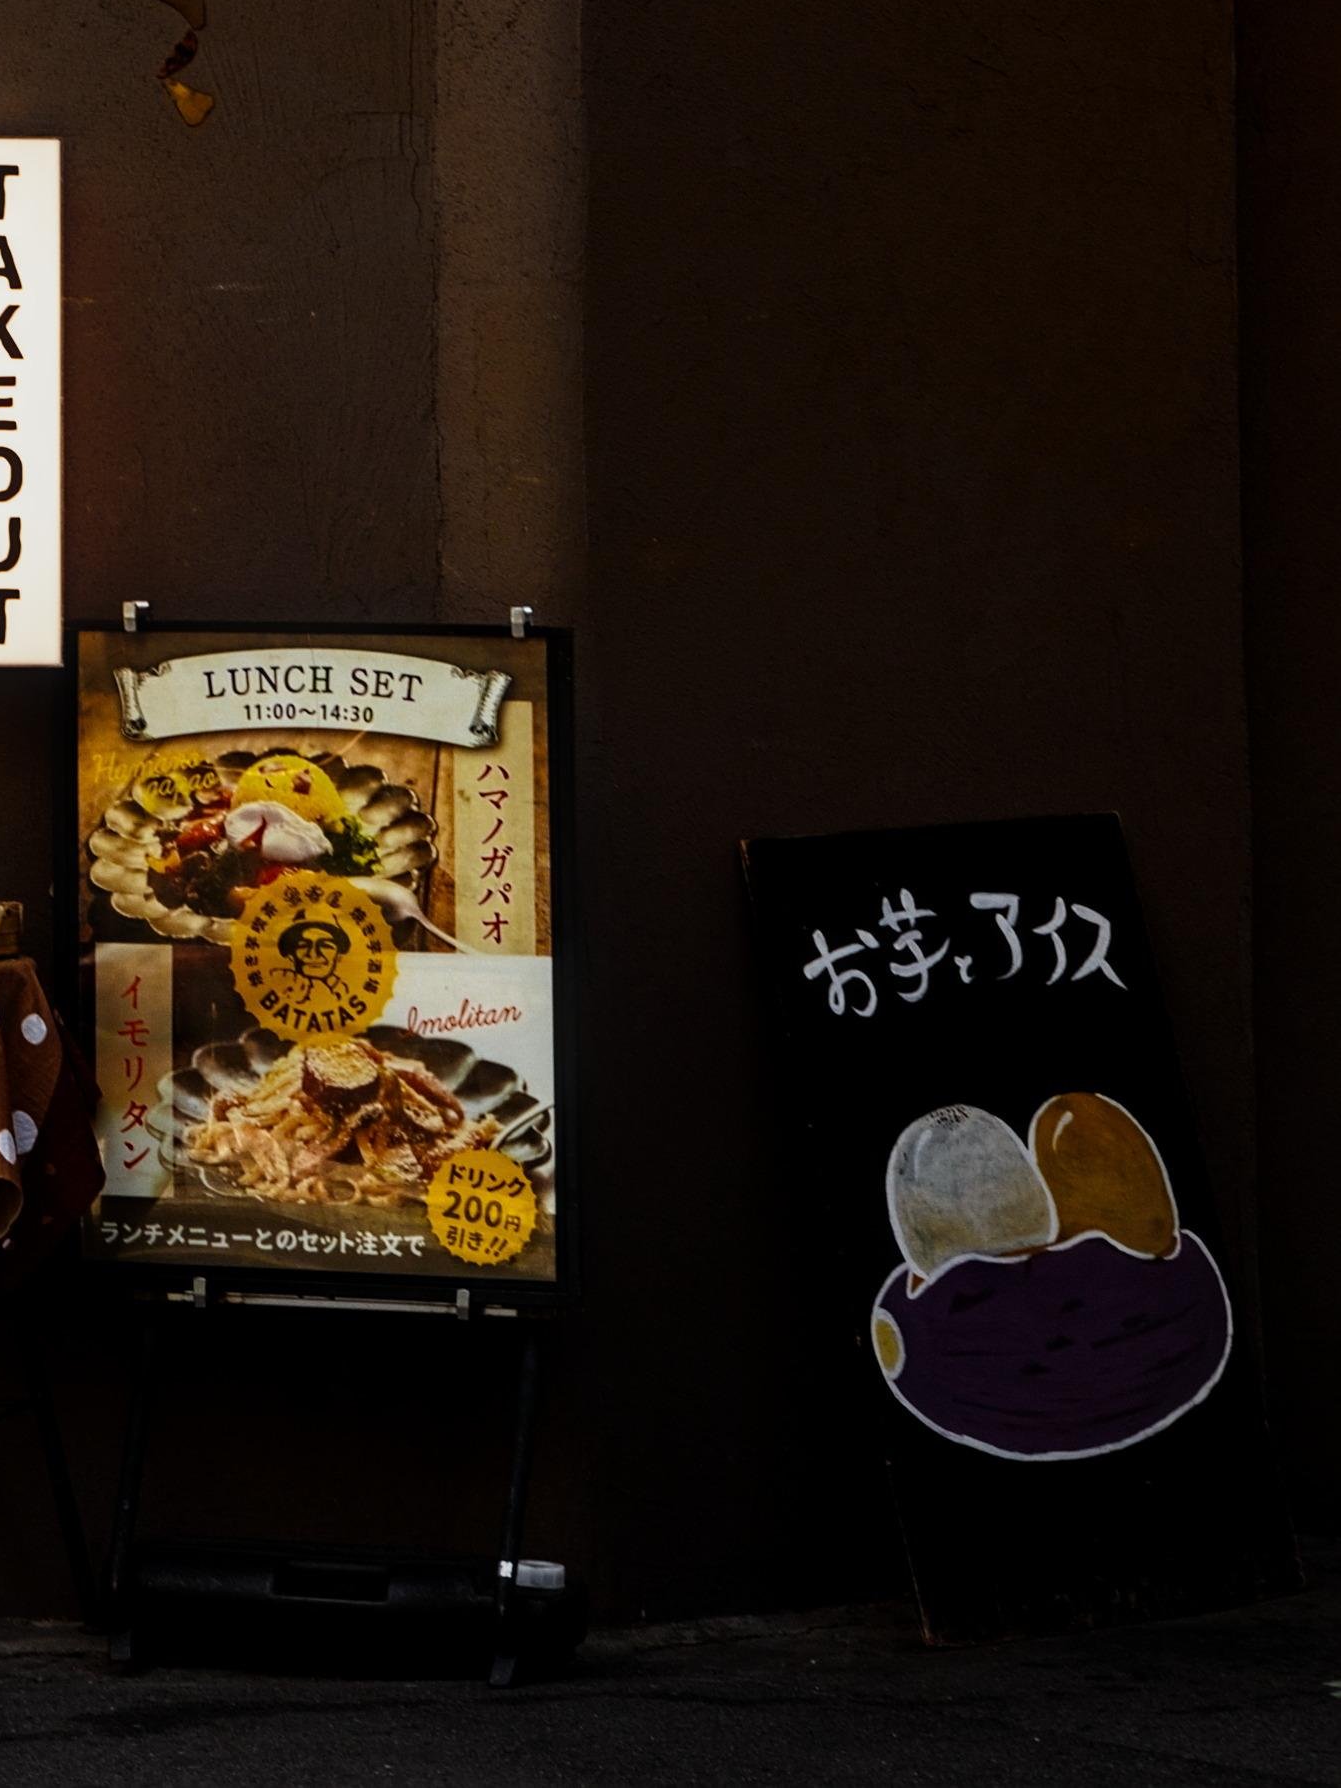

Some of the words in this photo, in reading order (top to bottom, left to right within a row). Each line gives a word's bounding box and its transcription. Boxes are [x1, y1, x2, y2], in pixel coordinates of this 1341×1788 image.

[204, 665, 332, 699] LUNCH
[349, 668, 424, 702] SET
[476, 762, 515, 945] ハマノガパオ
[803, 888, 1128, 1017] お芋とアイス
[260, 990, 367, 1033] BATATAS
[117, 974, 152, 1170] イモリタン
[447, 1161, 527, 1195] ドリンク
[443, 1195, 522, 1234] 200円
[100, 1220, 427, 1258] ランチメニューとのセット注文で
